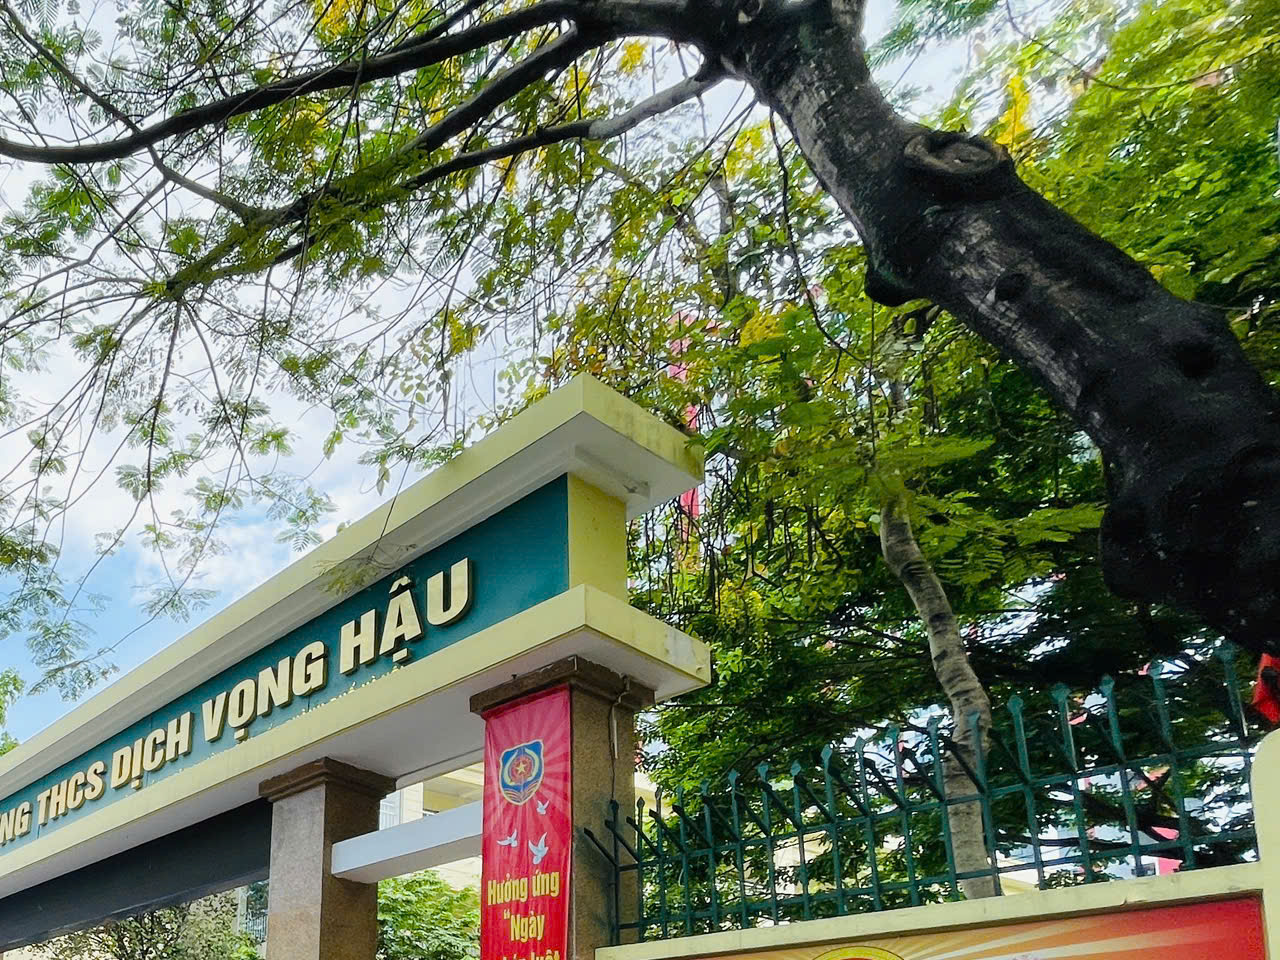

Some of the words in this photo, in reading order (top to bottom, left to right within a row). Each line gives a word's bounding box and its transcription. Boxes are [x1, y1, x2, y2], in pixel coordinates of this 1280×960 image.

[36, 760, 106, 826] THCS
[110, 711, 193, 790] DỊCH
[201, 640, 327, 743] VỌNG
[339, 557, 473, 664] HẬU
[487, 873, 528, 906] Hưởng
[531, 871, 560, 898] ứng
